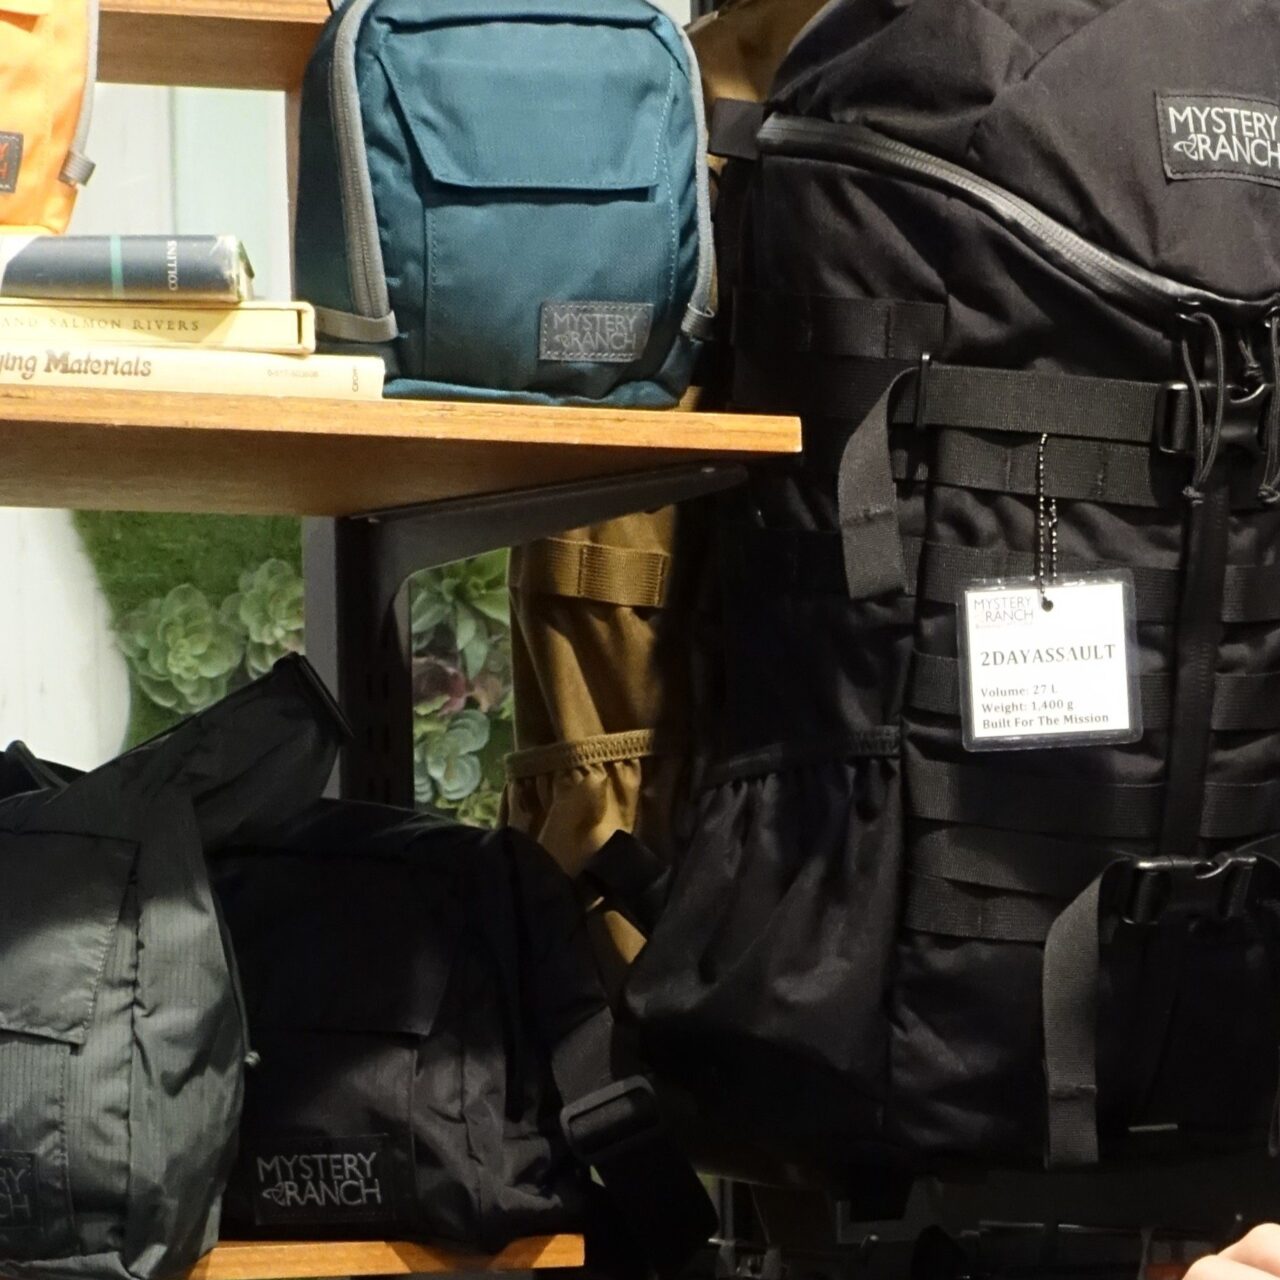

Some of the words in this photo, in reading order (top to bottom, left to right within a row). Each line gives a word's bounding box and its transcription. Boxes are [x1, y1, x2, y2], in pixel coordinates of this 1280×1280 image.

[1168, 106, 1278, 141] MYSTERY
[167, 239, 178, 292] COLLINS
[49, 317, 121, 329] SALMON
[133, 319, 200, 331] RIVERS
[553, 311, 638, 333] MYSTERY
[570, 329, 637, 353] RANCH
[43, 349, 152, 377] Materials
[974, 595, 1032, 612] MYSTERY
[985, 609, 1034, 623] RANCH
[980, 643, 1117, 666] 2DAYASSAULT
[980, 686, 1030, 698] Volume:
[1033, 684, 1047, 695] 27
[981, 702, 1028, 715] Weight:
[1067, 700, 1074, 711] g
[982, 718, 1011, 729] Built
[1014, 717, 1034, 727] For
[1038, 715, 1060, 726] The
[1063, 713, 1110, 725] Mission
[256, 1151, 377, 1183] MYSTERY
[284, 1178, 382, 1207] RANCH
